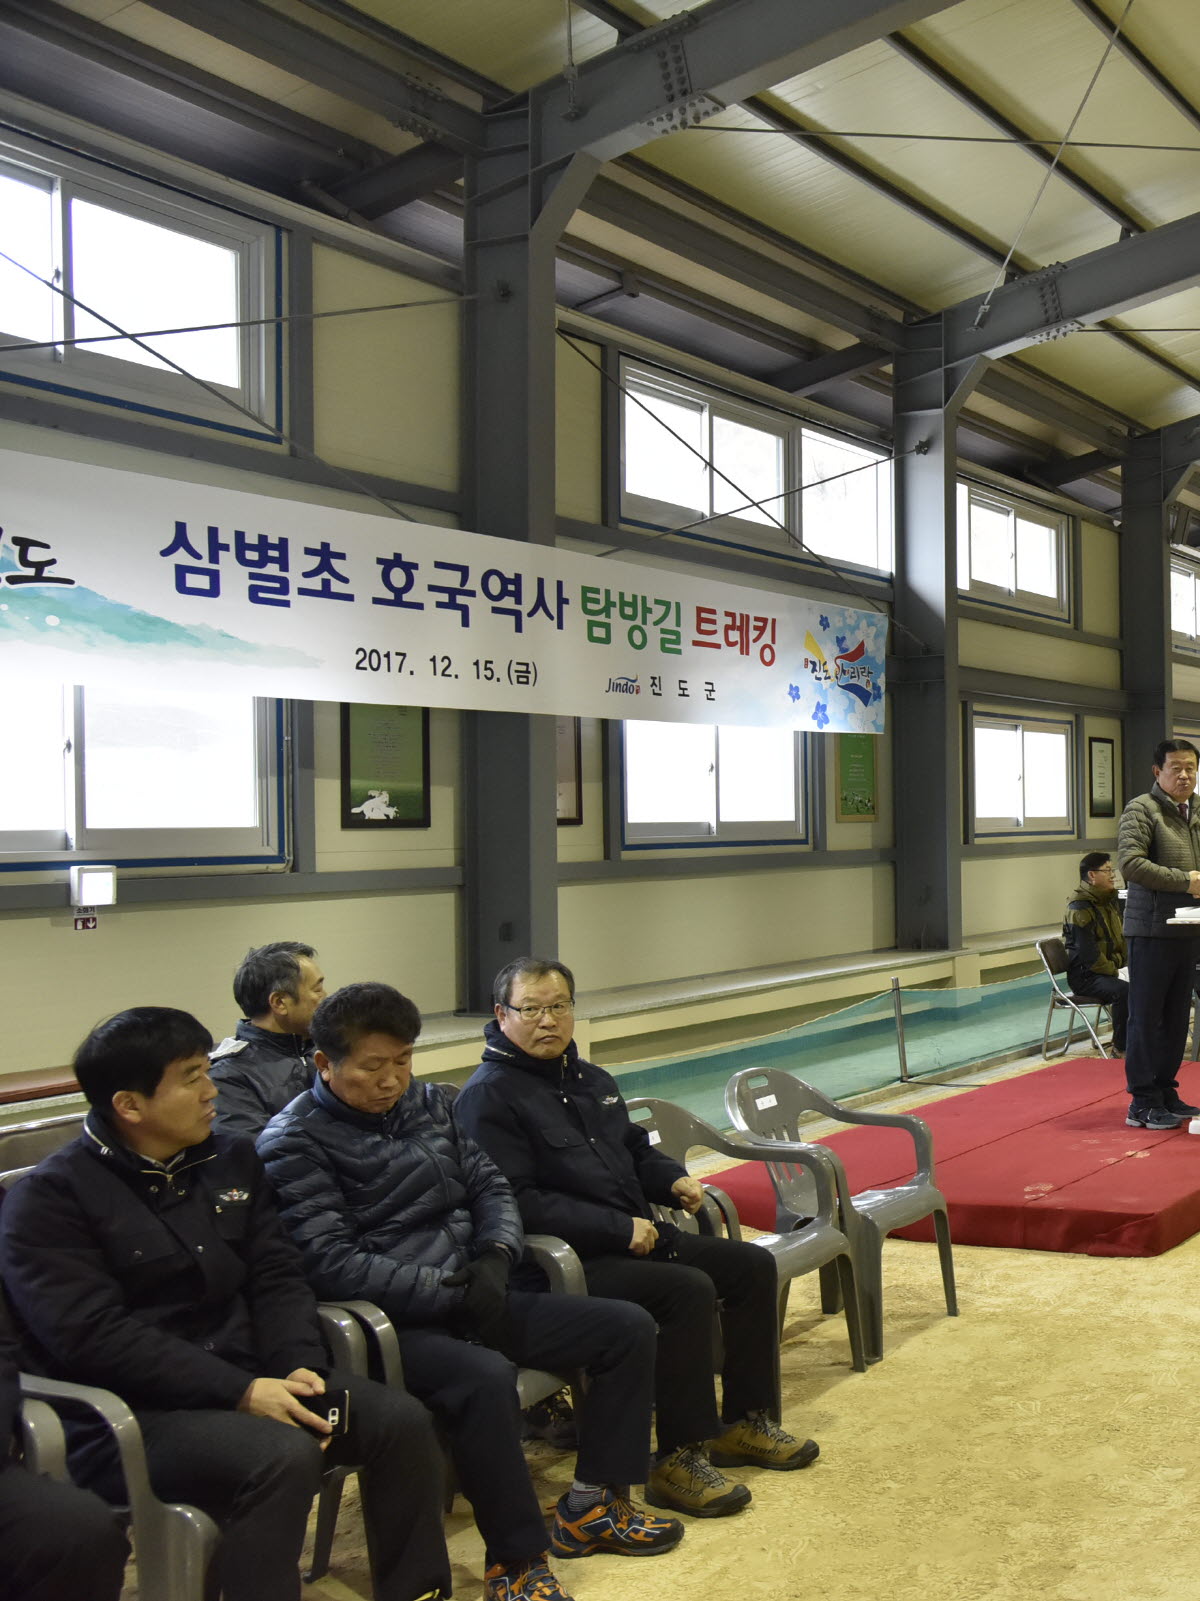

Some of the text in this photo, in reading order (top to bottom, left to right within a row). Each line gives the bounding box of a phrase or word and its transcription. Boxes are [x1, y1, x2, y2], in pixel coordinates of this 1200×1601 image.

[0, 526, 76, 586] 도
[159, 520, 777, 667] 삼별초 호국역사 탐방길 트레킹
[354, 647, 415, 676] 2017.
[429, 655, 459, 680] 12.
[605, 677, 636, 695] Jindo
